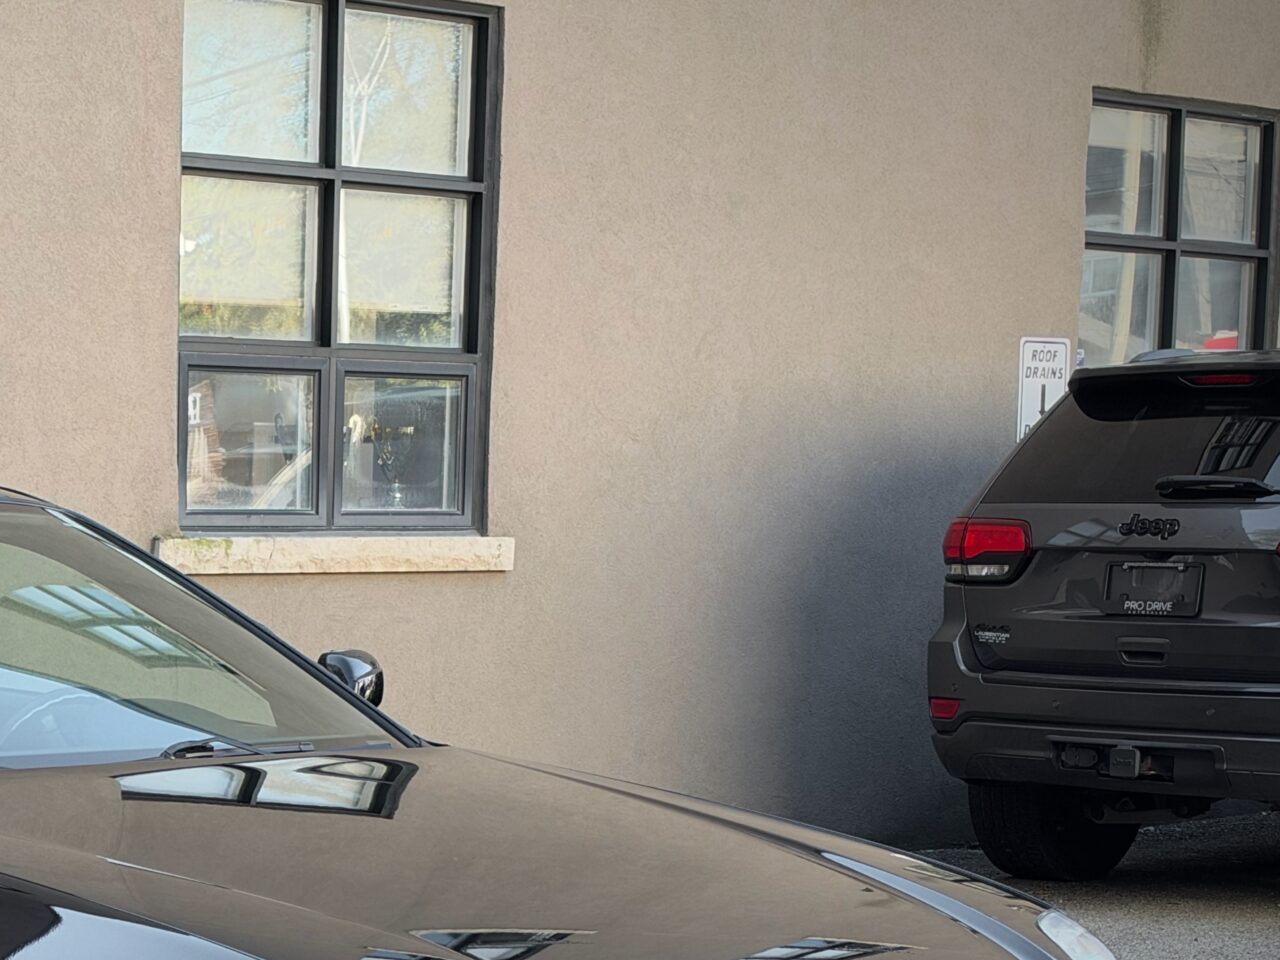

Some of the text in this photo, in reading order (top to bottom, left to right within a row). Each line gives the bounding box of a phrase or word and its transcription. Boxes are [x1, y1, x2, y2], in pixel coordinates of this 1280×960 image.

[1031, 349, 1058, 362] ROOF
[1025, 366, 1063, 380] DRAINS
[1119, 513, 1180, 541] Jeep
[1124, 600, 1173, 611] PRO DRIVE
